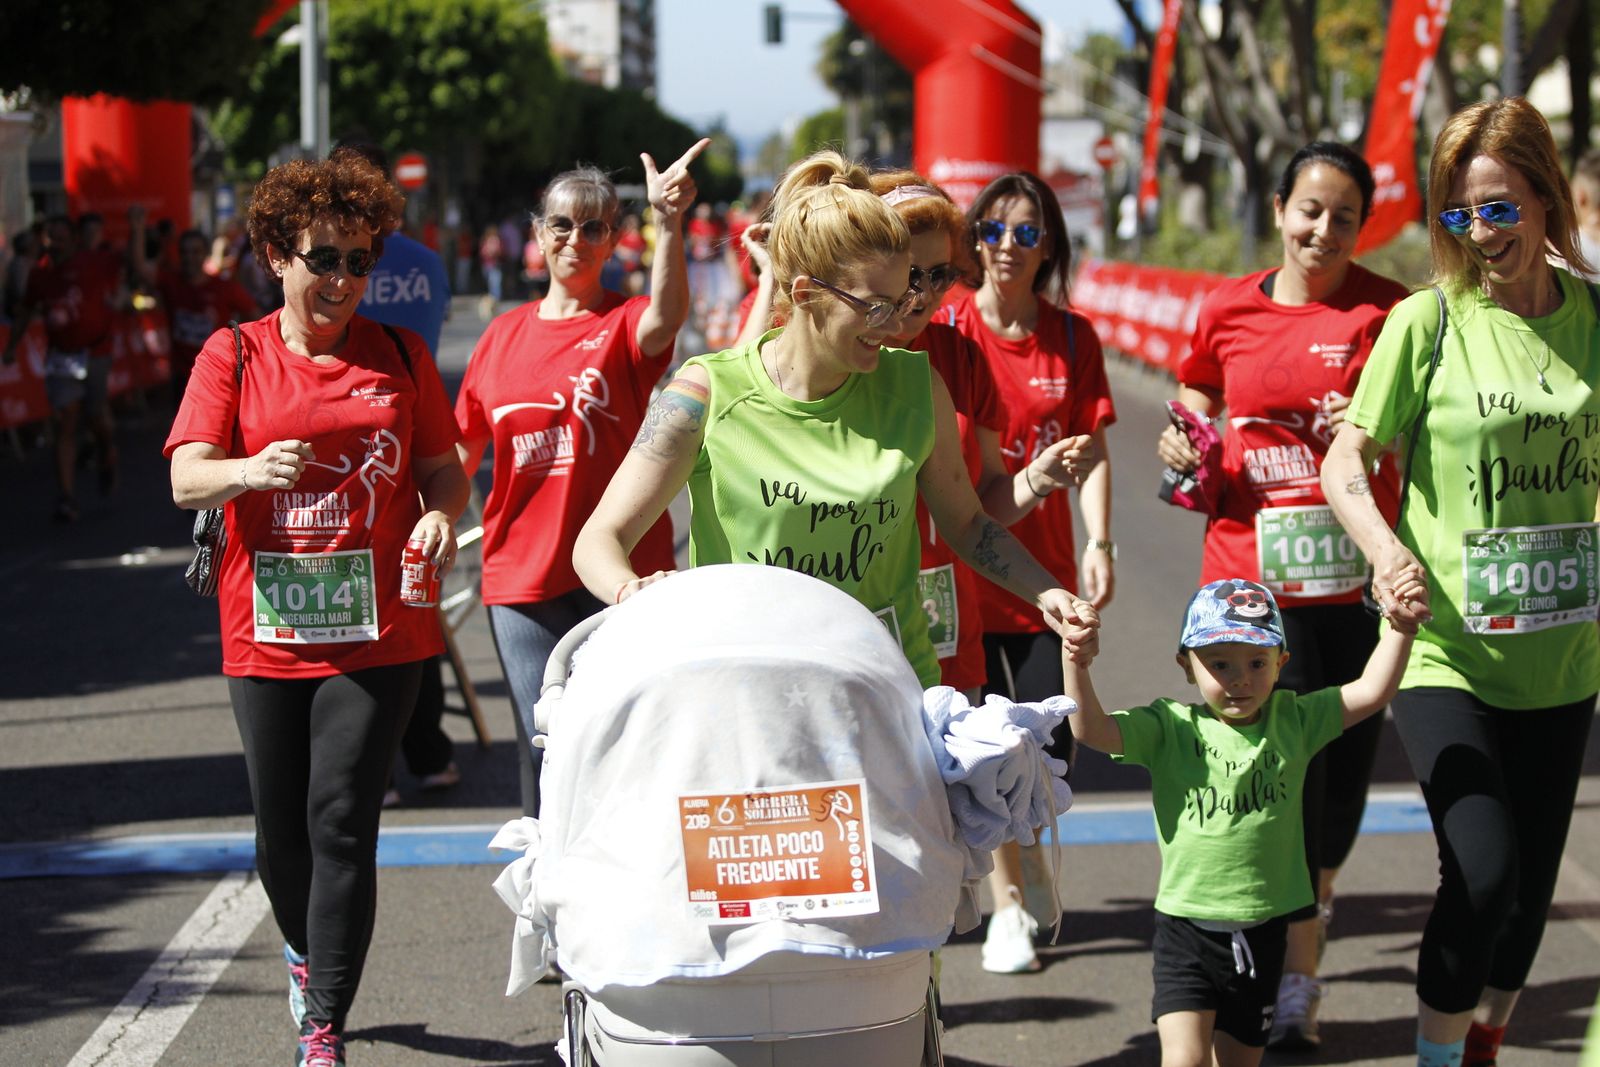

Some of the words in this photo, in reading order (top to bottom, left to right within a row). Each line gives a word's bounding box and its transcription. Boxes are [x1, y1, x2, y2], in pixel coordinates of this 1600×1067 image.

[1523, 411, 1575, 444] por
[273, 492, 350, 511] CARRERA
[810, 500, 866, 533] por
[872, 498, 900, 524] ti
[272, 511, 351, 528] SOLIDARIA
[1273, 534, 1356, 565] 1010
[277, 558, 288, 576] 6
[294, 558, 337, 567] CARRERA
[1480, 558, 1579, 595] 1005
[265, 580, 354, 611] 1014
[1519, 596, 1558, 611] LEONOR
[258, 613, 270, 625] 3k
[280, 613, 327, 625] INGENIERA
[328, 611, 352, 624] MARI
[685, 813, 711, 829] 2019
[744, 805, 810, 820] SOLIDARIA
[717, 797, 735, 825] 6
[743, 793, 808, 811] CARRERA
[708, 834, 775, 859] ATLETA
[776, 831, 824, 855] POCO
[716, 857, 821, 885] FRECUENTE
